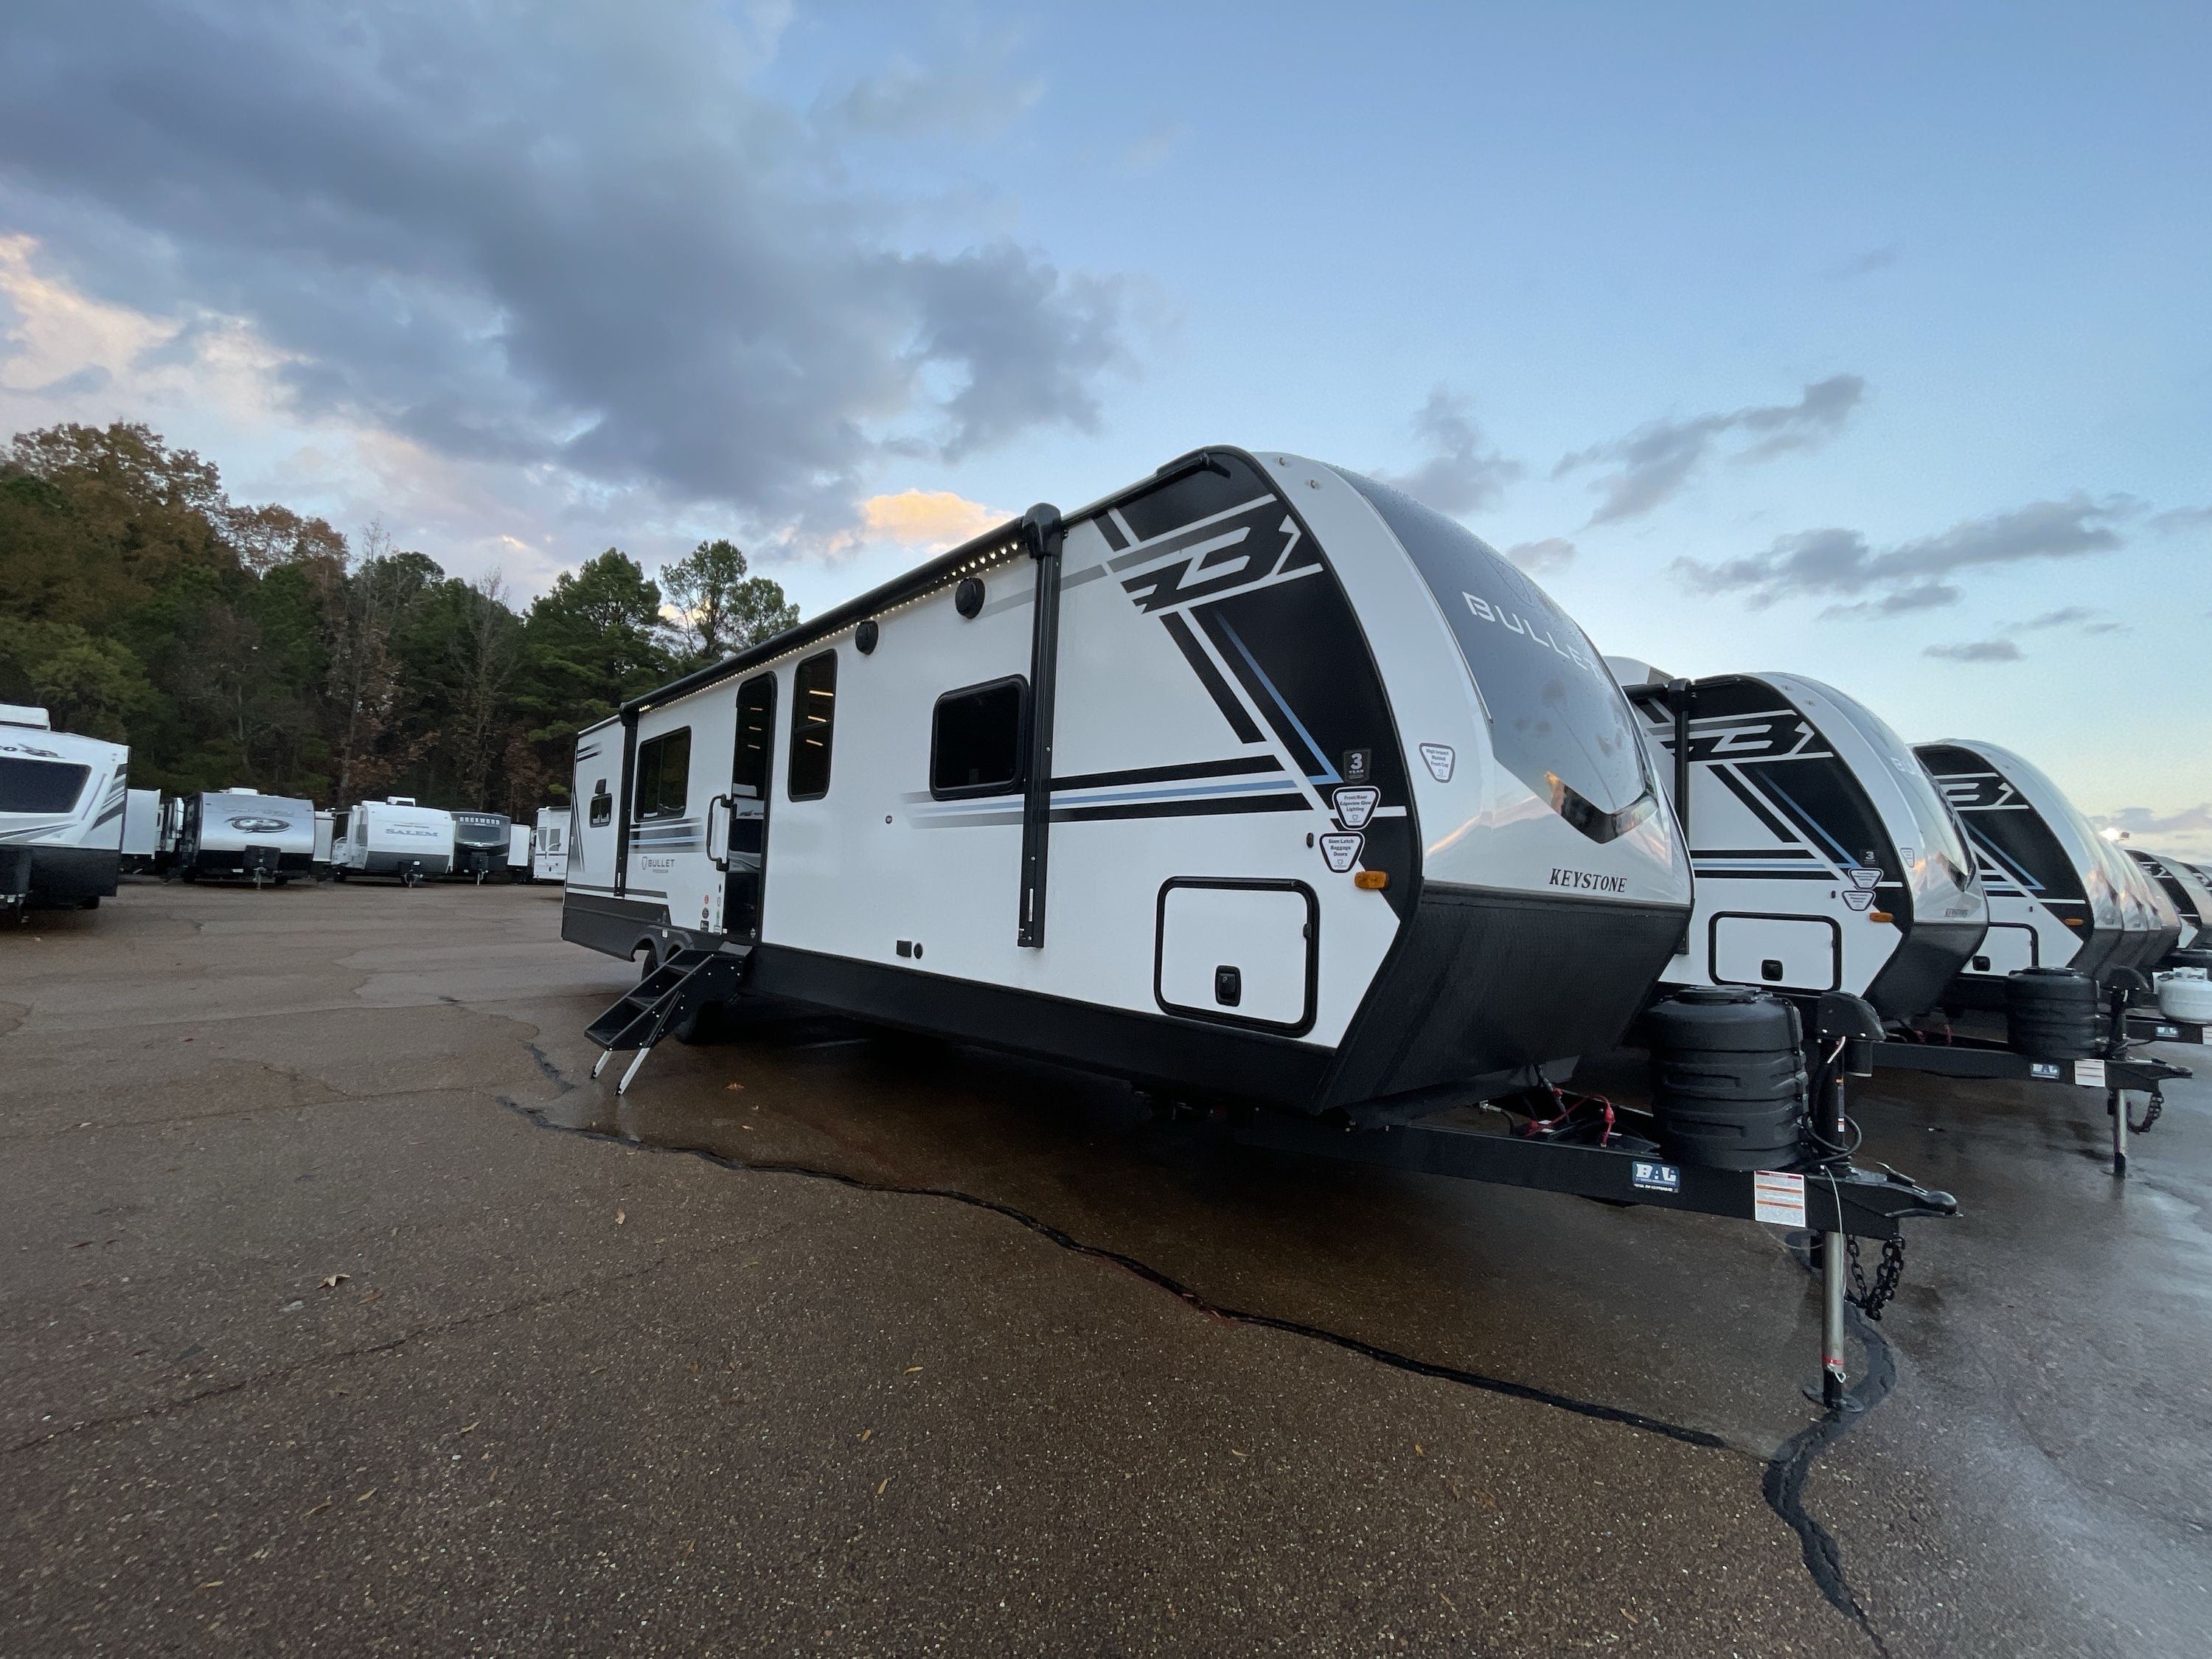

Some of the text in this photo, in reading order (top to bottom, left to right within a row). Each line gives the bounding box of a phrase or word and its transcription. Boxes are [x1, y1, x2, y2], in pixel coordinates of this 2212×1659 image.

[1462, 591, 1600, 681] BULLET
[1350, 753, 1363, 770] 3
[386, 828, 438, 837] SALEM
[647, 859, 675, 867] BULLET
[1549, 867, 1627, 893] KEYSTONE
[1635, 1163, 1677, 1183] BAL
